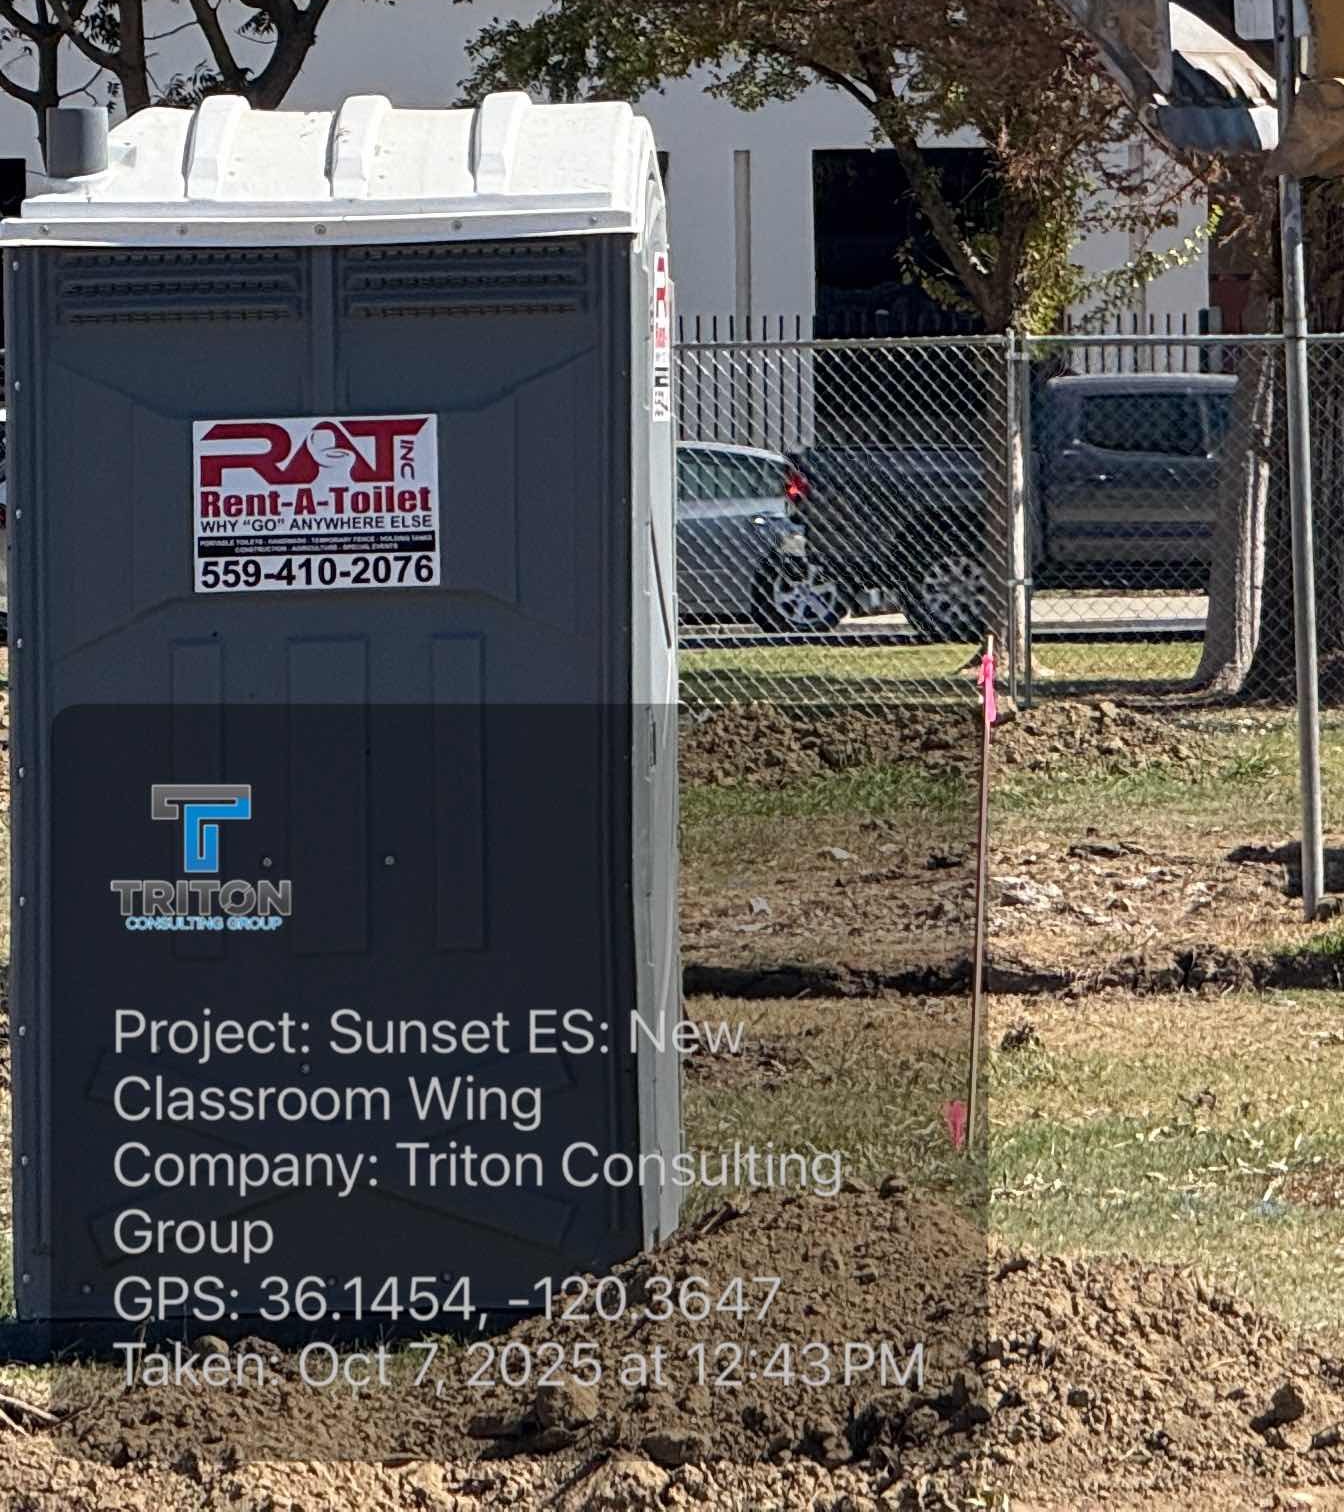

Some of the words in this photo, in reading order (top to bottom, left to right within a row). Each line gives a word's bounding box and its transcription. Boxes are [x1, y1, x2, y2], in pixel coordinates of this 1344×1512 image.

[400, 439, 415, 481] INC
[200, 486, 433, 518] Rent-A-Toilet
[200, 519, 239, 533] WHY
[289, 515, 385, 531] ANYWHERE
[390, 514, 433, 529] ELSE
[201, 554, 434, 589] 559-410-2076
